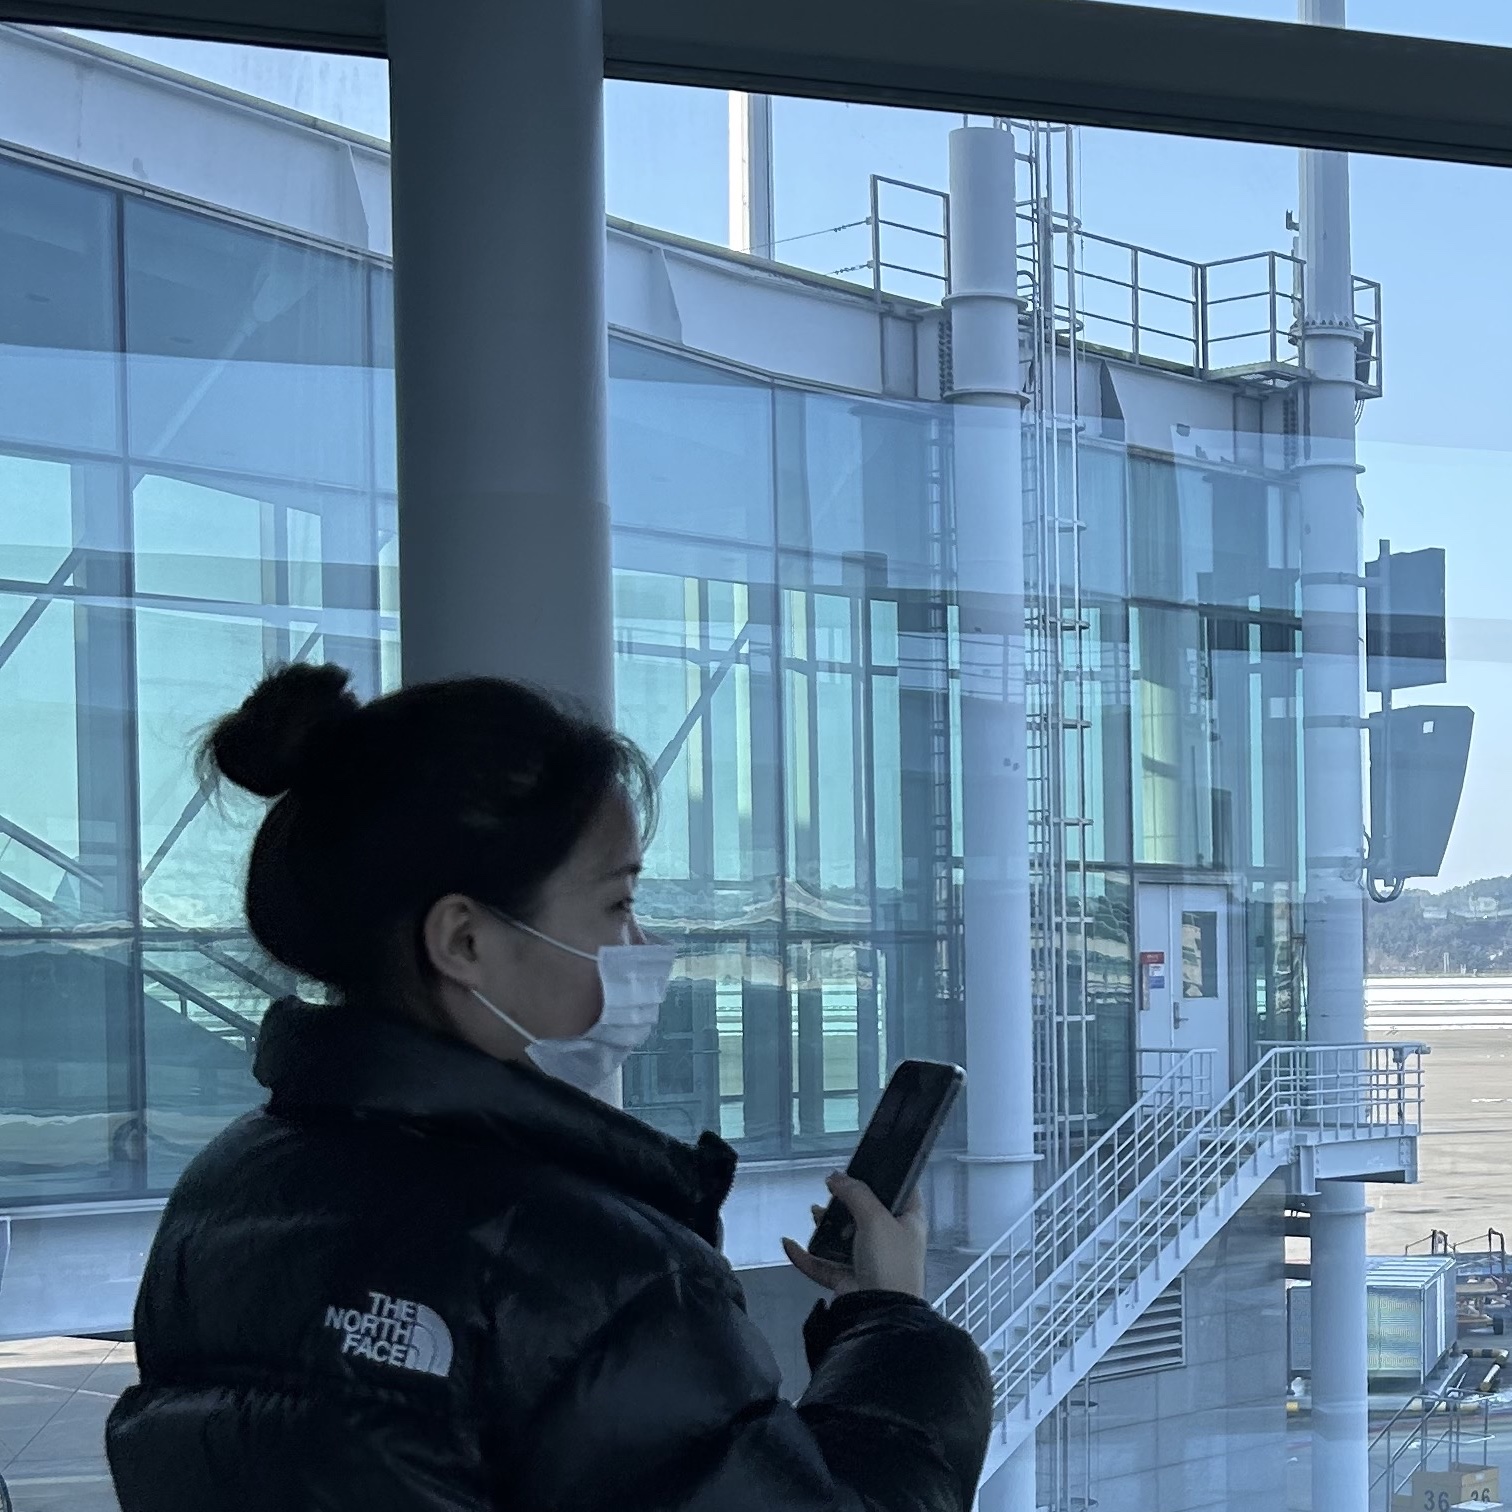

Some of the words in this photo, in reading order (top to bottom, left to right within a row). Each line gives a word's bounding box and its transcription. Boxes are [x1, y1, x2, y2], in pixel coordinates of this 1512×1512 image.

[369, 1291, 418, 1324] THE
[324, 1304, 413, 1345] NORTH
[342, 1333, 407, 1366] FACE
[1424, 1490, 1450, 1512] 36
